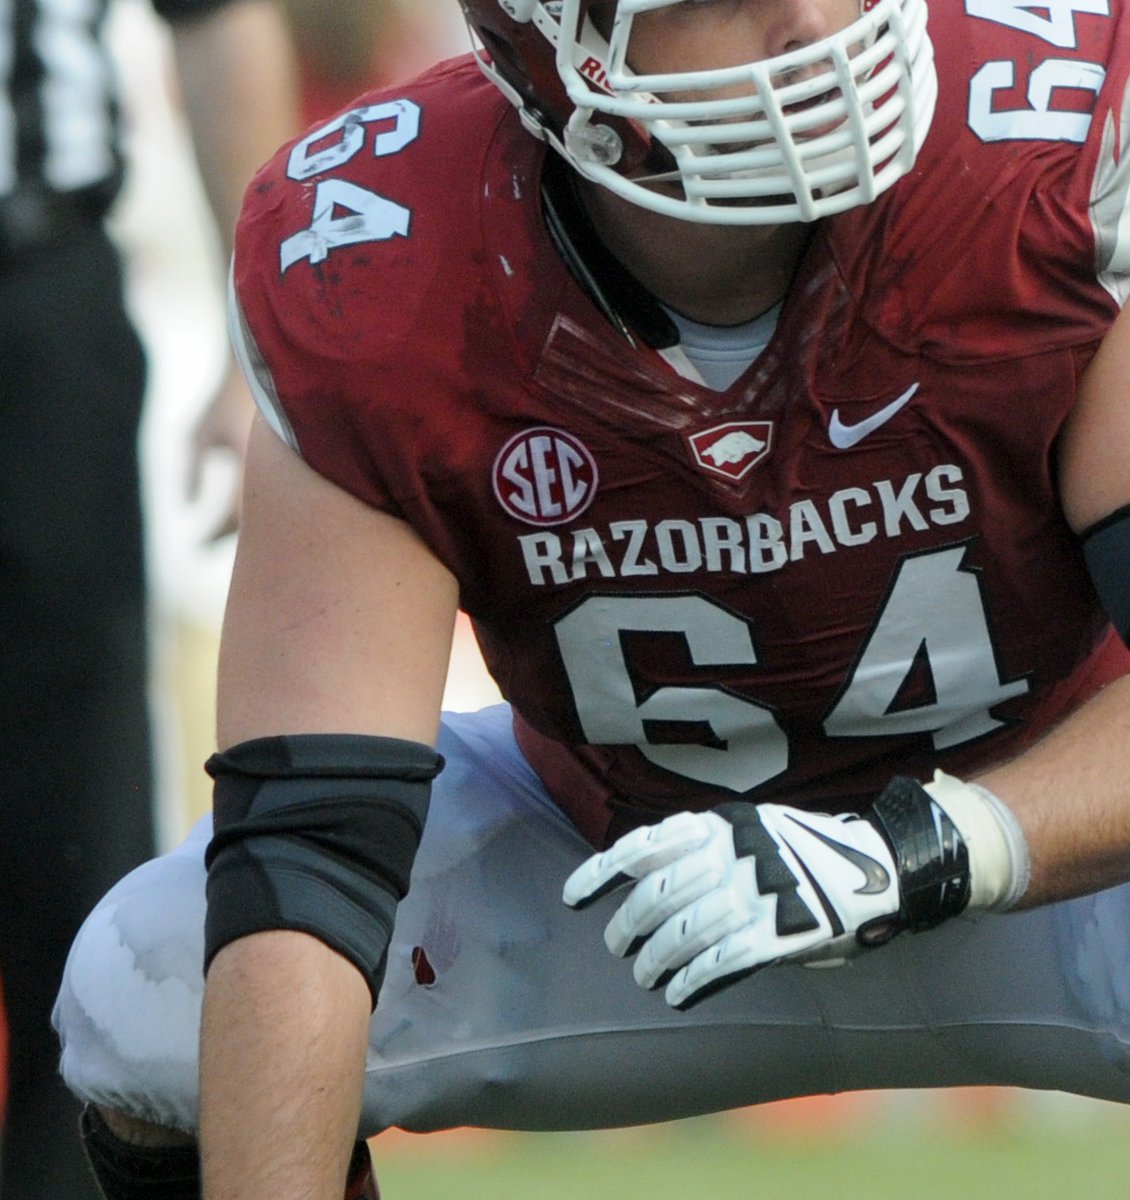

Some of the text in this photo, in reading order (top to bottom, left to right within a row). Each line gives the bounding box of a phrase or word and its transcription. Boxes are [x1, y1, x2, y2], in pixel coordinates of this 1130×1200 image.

[280, 97, 422, 275] 64
[501, 436, 592, 518] SEC
[517, 464, 971, 587] RAZORBACKS
[549, 537, 1036, 796] 64
